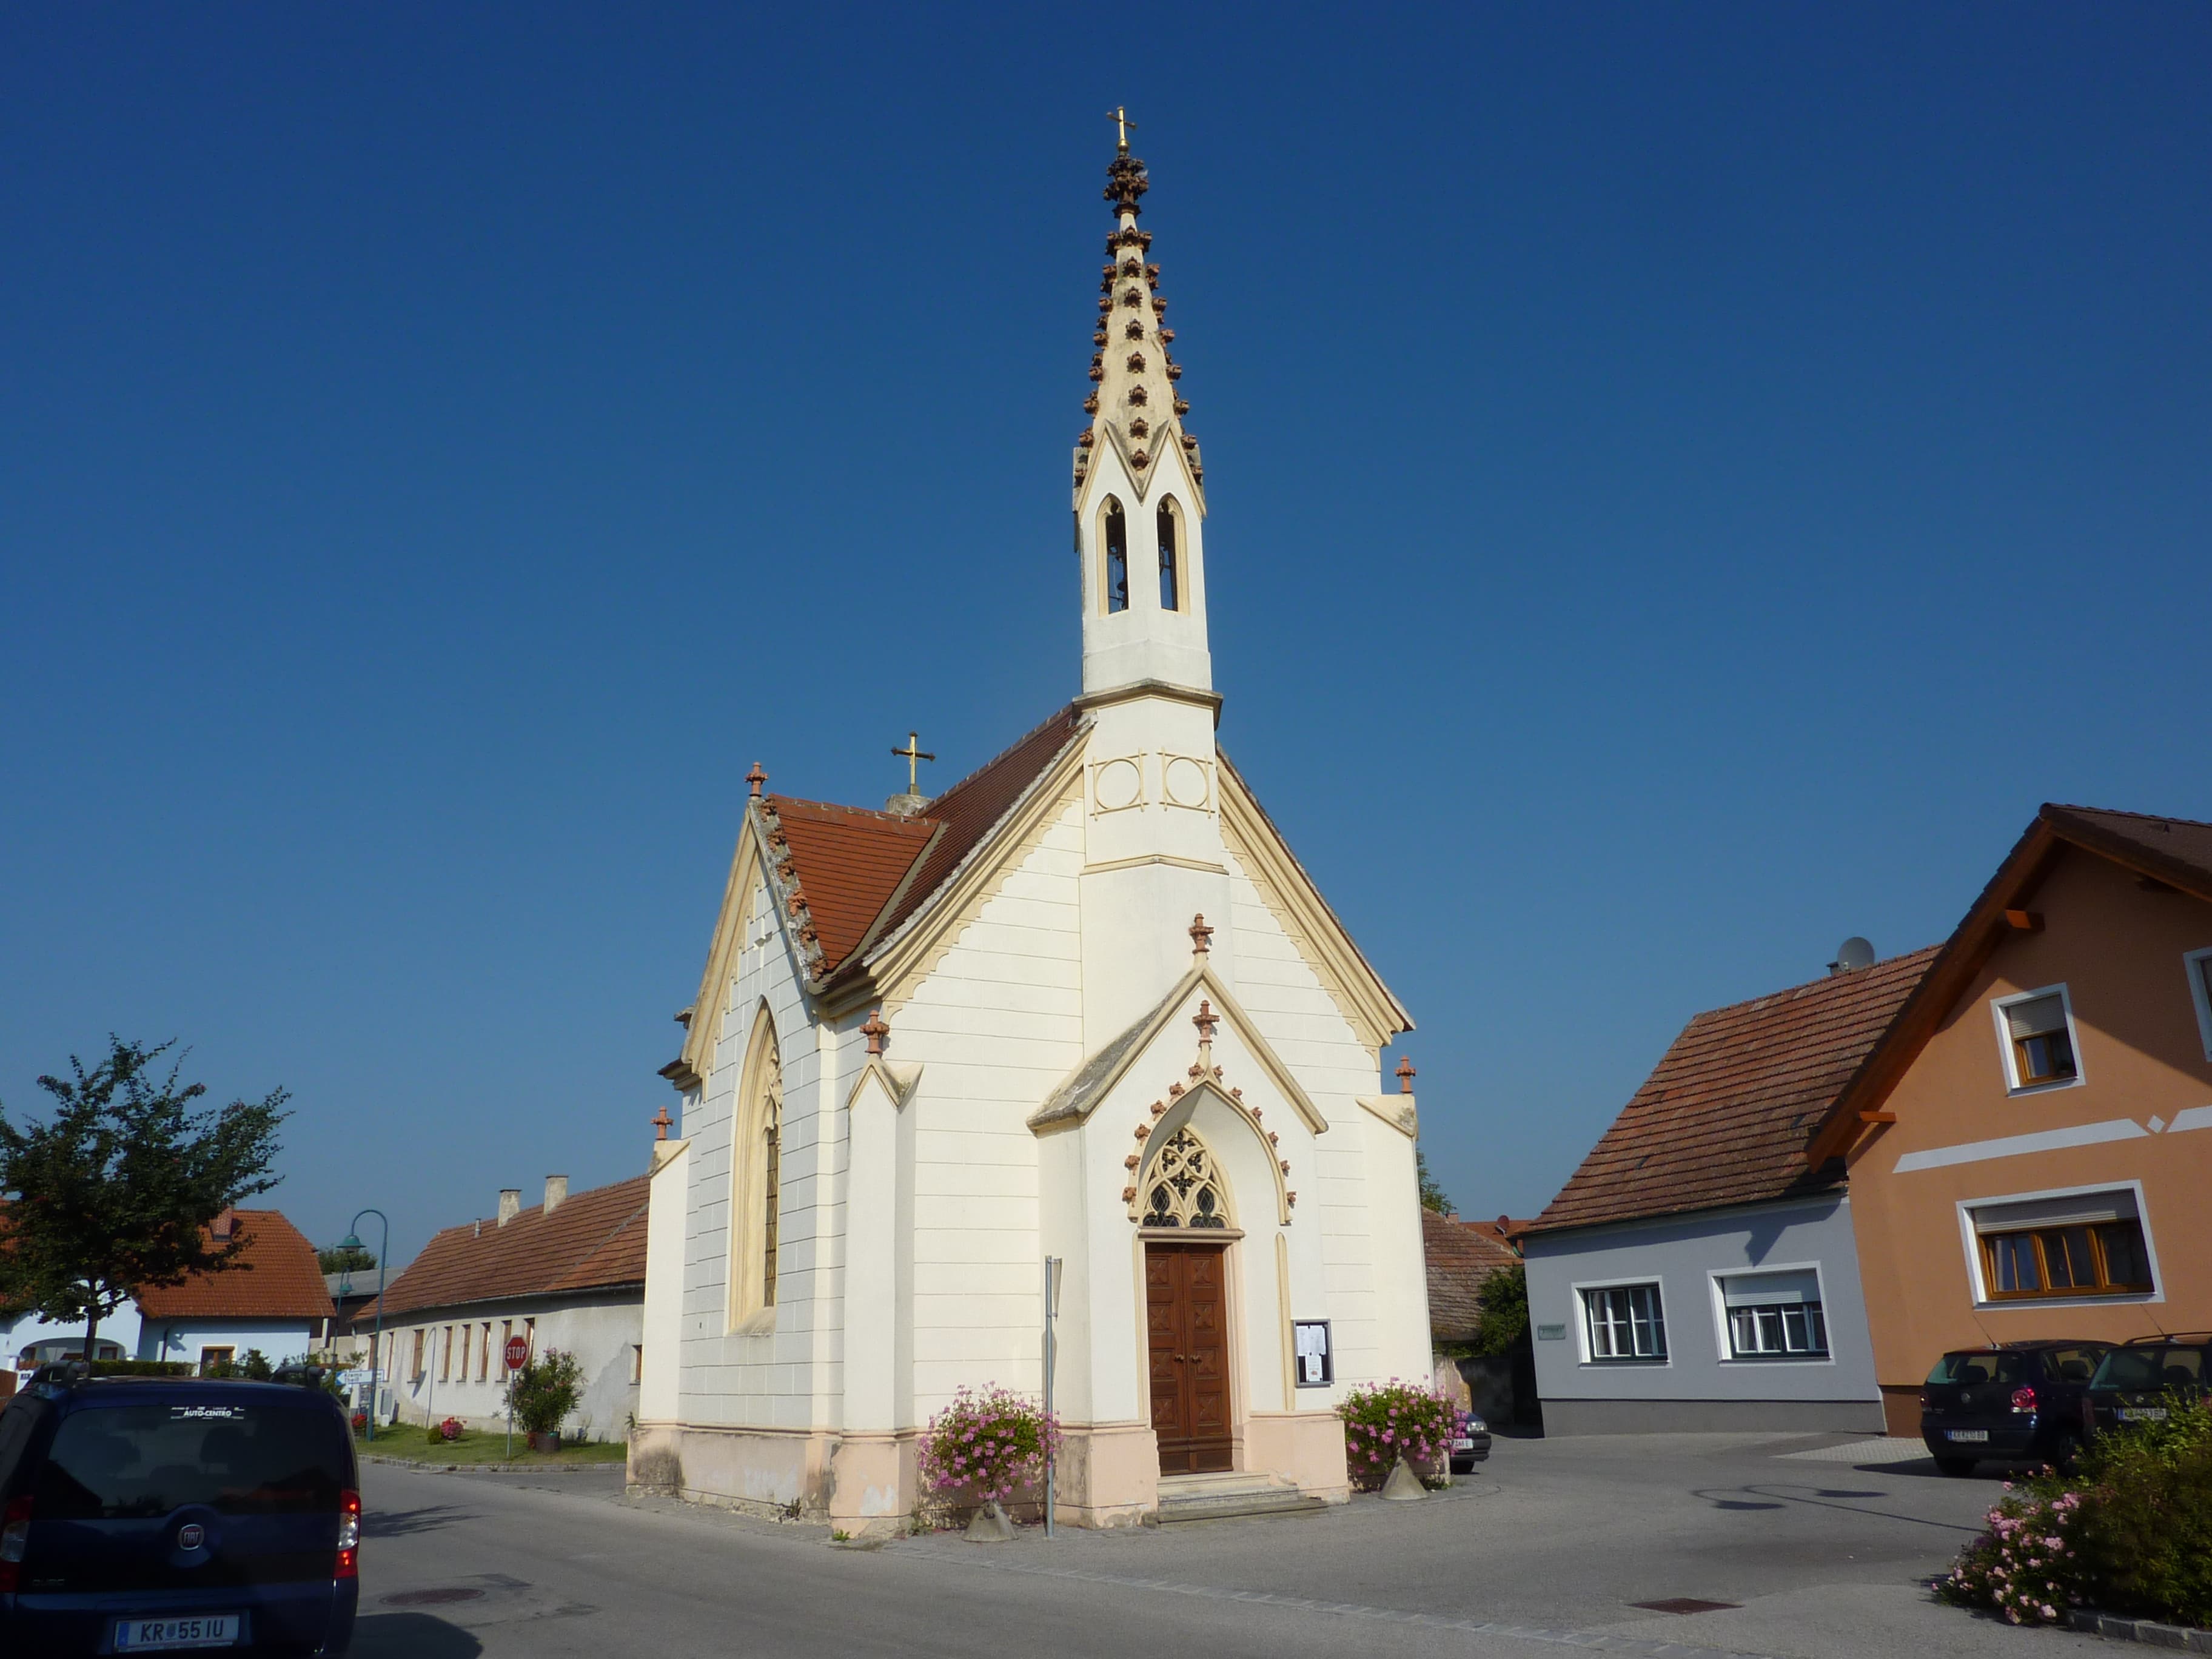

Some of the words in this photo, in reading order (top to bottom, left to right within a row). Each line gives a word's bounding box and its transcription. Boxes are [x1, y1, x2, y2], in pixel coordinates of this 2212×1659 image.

[507, 1346, 526, 1360] STOP
[183, 1532, 199, 1543] FIAT
[140, 1623, 164, 1642] KR
[178, 1621, 201, 1639] 55
[206, 1620, 224, 1638] IU
